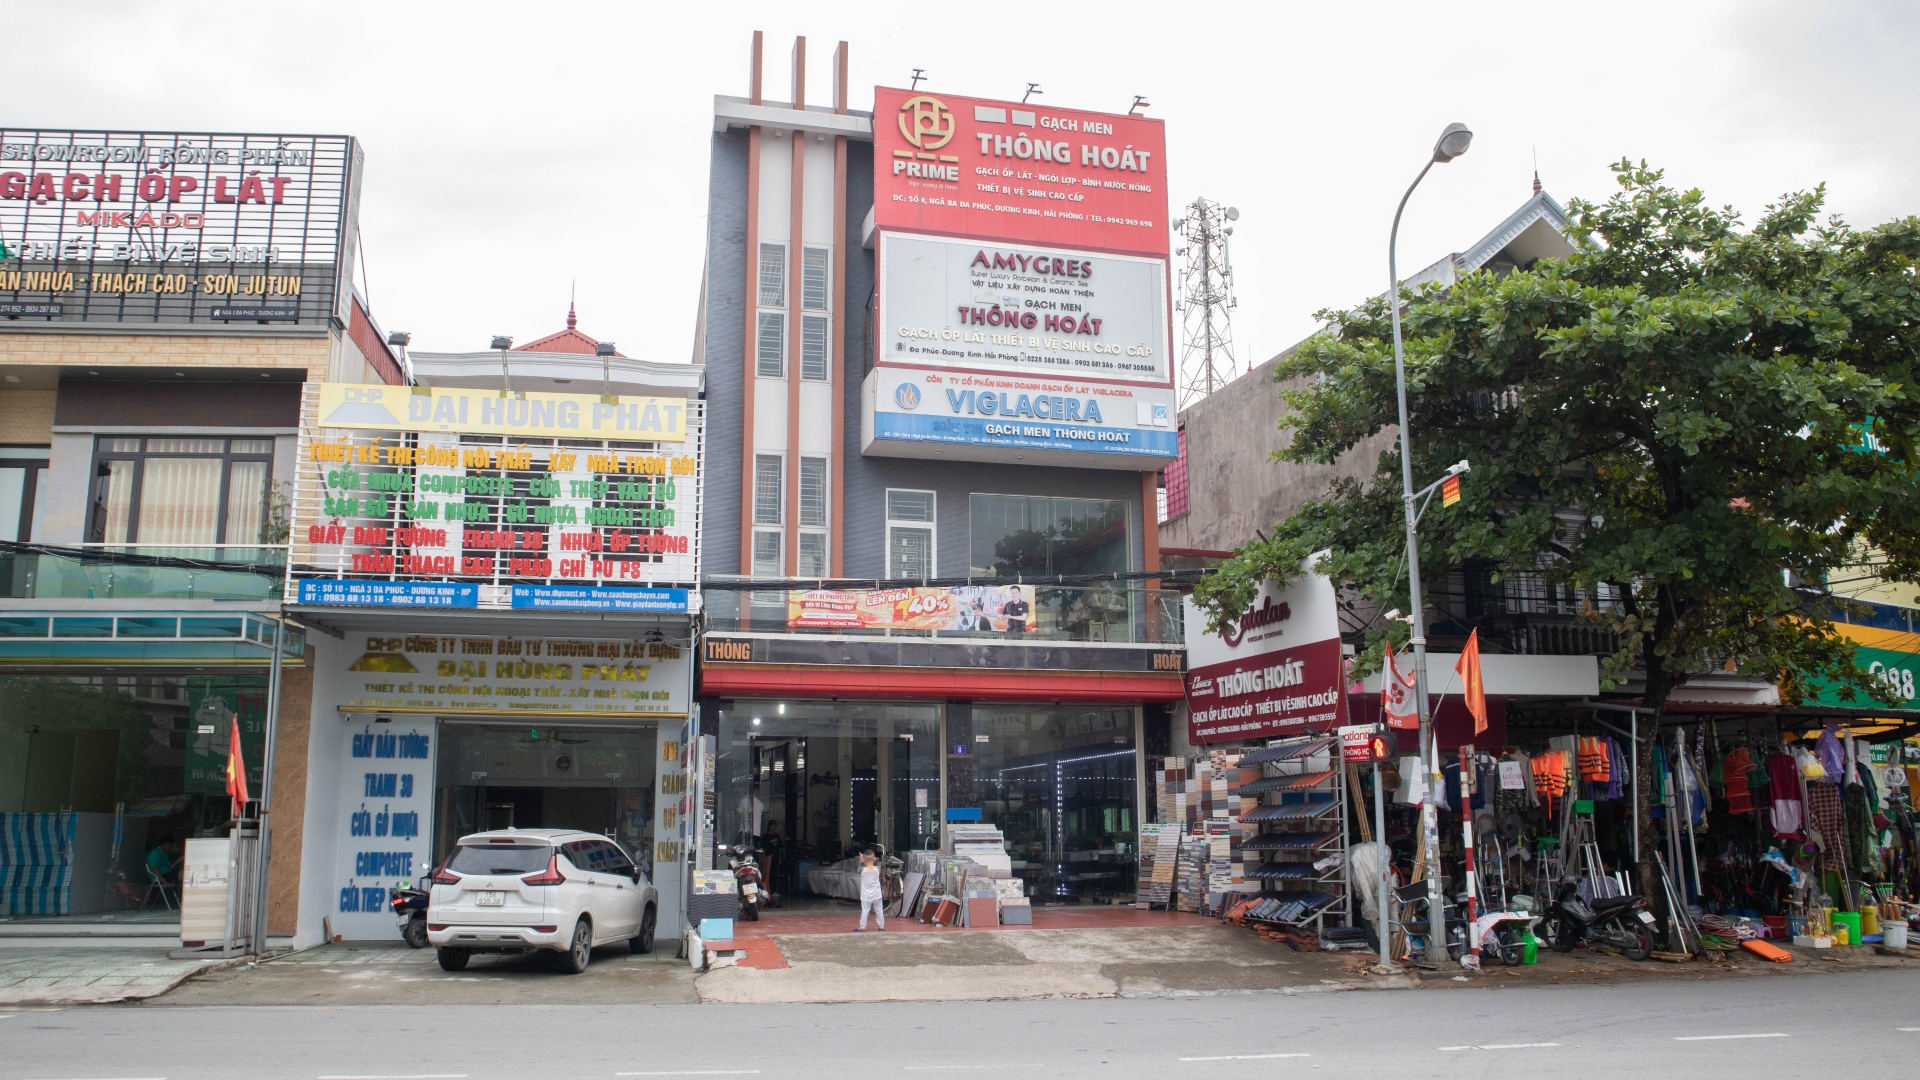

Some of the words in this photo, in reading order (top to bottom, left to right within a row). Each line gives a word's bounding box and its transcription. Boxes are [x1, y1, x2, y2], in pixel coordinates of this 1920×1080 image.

[1040, 116, 1078, 132] GẠCH
[1083, 119, 1113, 136] MEN
[2, 143, 149, 164] SHOWROOM
[976, 132, 1071, 163] THÔNG
[1082, 144, 1151, 174] HOÁT
[893, 160, 959, 181] PRIME
[976, 167, 998, 178] GẠCH
[1002, 166, 1014, 177] ỐP
[1017, 168, 1033, 180] LÁT
[1082, 176, 1102, 187] BÌNH
[1104, 177, 1126, 190] NƯỚC
[1128, 179, 1152, 192] NÓNG
[0, 171, 122, 206] GẠCH
[139, 164, 197, 204] ỐP
[214, 170, 292, 205] LÁT
[976, 182, 999, 192] THIẾT
[1002, 186, 1011, 196] BỊ
[1014, 185, 1024, 198] VỆ
[1027, 188, 1046, 198] SINH
[1048, 190, 1066, 200] CAO
[1068, 192, 1084, 202] CẤP
[76, 211, 205, 229] MIKADO
[1107, 216, 1124, 226] 0942
[1126, 219, 1138, 227] 969
[1140, 220, 1152, 228] 698
[10, 236, 100, 261] THIẾT
[113, 245, 140, 267] BỊ
[156, 240, 197, 267] VỆ
[208, 246, 279, 265] SINH
[971, 250, 1093, 280] AMYGRES
[25, 269, 75, 296] NHỰA
[91, 272, 147, 297] THẠCH
[152, 274, 188, 295] CAO
[204, 272, 240, 295] SƠN
[244, 275, 302, 297] JUTUN
[1024, 299, 1057, 310] GẠCH
[1060, 302, 1082, 312] MEN
[958, 304, 1038, 329] THÔNG
[1044, 313, 1103, 336] HOÁT
[898, 325, 938, 341] GẠCH
[941, 324, 961, 340] ỐP
[964, 328, 987, 343] LÁT
[990, 330, 1024, 347] THIẾT
[1028, 336, 1040, 351] BỊ
[1043, 336, 1059, 352] VỆ
[1062, 340, 1090, 352] SINH
[1094, 342, 1121, 356] CAO
[1126, 340, 1153, 358] CẤP
[950, 377, 961, 386] TY
[962, 376, 973, 386] CỔ
[974, 377, 995, 389] PHẦN
[996, 380, 1013, 390] KINH
[1014, 382, 1040, 392] DOANH
[1042, 383, 1062, 394] GẠCH
[1064, 383, 1074, 395] ỐP
[1076, 386, 1090, 396] LÁT
[1093, 388, 1134, 398] VIGLACERA
[344, 388, 384, 403] DHP
[408, 394, 469, 430] ĐẠI
[482, 393, 580, 429] HÙNG
[592, 399, 683, 433] PHÁT
[946, 388, 1103, 424] VIGLACERA
[986, 424, 1022, 440] GẠCH
[1024, 426, 1051, 440] MEN
[1054, 426, 1096, 442] THÔNG
[1098, 430, 1131, 444] HOÁT
[309, 436, 355, 463] THIẾT
[358, 436, 383, 464] KẾ
[386, 446, 411, 465] THI
[415, 444, 459, 467] CÔNG
[463, 446, 491, 474] NỘI
[495, 443, 533, 470] THẤT
[548, 447, 577, 472] XÂY
[587, 449, 620, 474] NHÀ
[626, 456, 666, 480] TRỌN
[671, 454, 694, 476] GÓI
[328, 463, 361, 490] CỬA
[368, 472, 412, 497] NHỰA
[419, 473, 515, 498] COMPOSITE
[530, 471, 562, 498] CỬA
[569, 475, 609, 499] THÉP
[617, 476, 649, 501] VÂN
[323, 491, 358, 517] SÀN
[405, 494, 439, 520] SÀN
[444, 502, 490, 526] NHỰA
[534, 504, 578, 530] NHỰA
[584, 501, 634, 526] NGOÀI
[640, 502, 675, 527] TRỜI
[309, 518, 347, 545] GIẤY
[354, 520, 387, 546] DÁN
[394, 522, 446, 548] TƯỜNG
[463, 530, 516, 550] TRANH
[522, 531, 543, 550] 3D
[610, 528, 632, 552] ỐP
[638, 529, 688, 554] TƯỜNG
[352, 547, 396, 573] TRẦN
[402, 555, 455, 580] THẠCH
[461, 556, 492, 576] CAO
[510, 552, 552, 577] PHÀO
[592, 560, 614, 578] PU
[620, 561, 641, 580] PS
[322, 582, 333, 592] SỐ
[334, 584, 344, 592] 10
[350, 584, 365, 594] NGÃ
[386, 585, 404, 594] PHÚC
[437, 588, 455, 596] KINH
[461, 588, 472, 596] HP
[324, 594, 345, 602] 0983
[392, 596, 414, 604] 0902
[866, 594, 886, 606] LÊN
[888, 590, 909, 602] ĐẾN
[908, 596, 948, 614] 40%
[708, 638, 751, 660] THÔNG
[1153, 650, 1183, 671] HOÁT
[438, 661, 487, 682] ĐẠI
[496, 658, 573, 681] HÙNG
[581, 661, 652, 682] PHÁT
[1216, 668, 1264, 698] THÔNG
[1264, 658, 1304, 690] HOÁT
[1290, 696, 1308, 711] SINH
[1308, 692, 1324, 708] CAO
[1322, 686, 1338, 706] CẤP
[364, 773, 398, 798] TRANH
[400, 773, 414, 798] 3D
[356, 851, 413, 878] COMPOSITE
[340, 878, 360, 913] CỬA
[362, 880, 386, 913] THÉP
